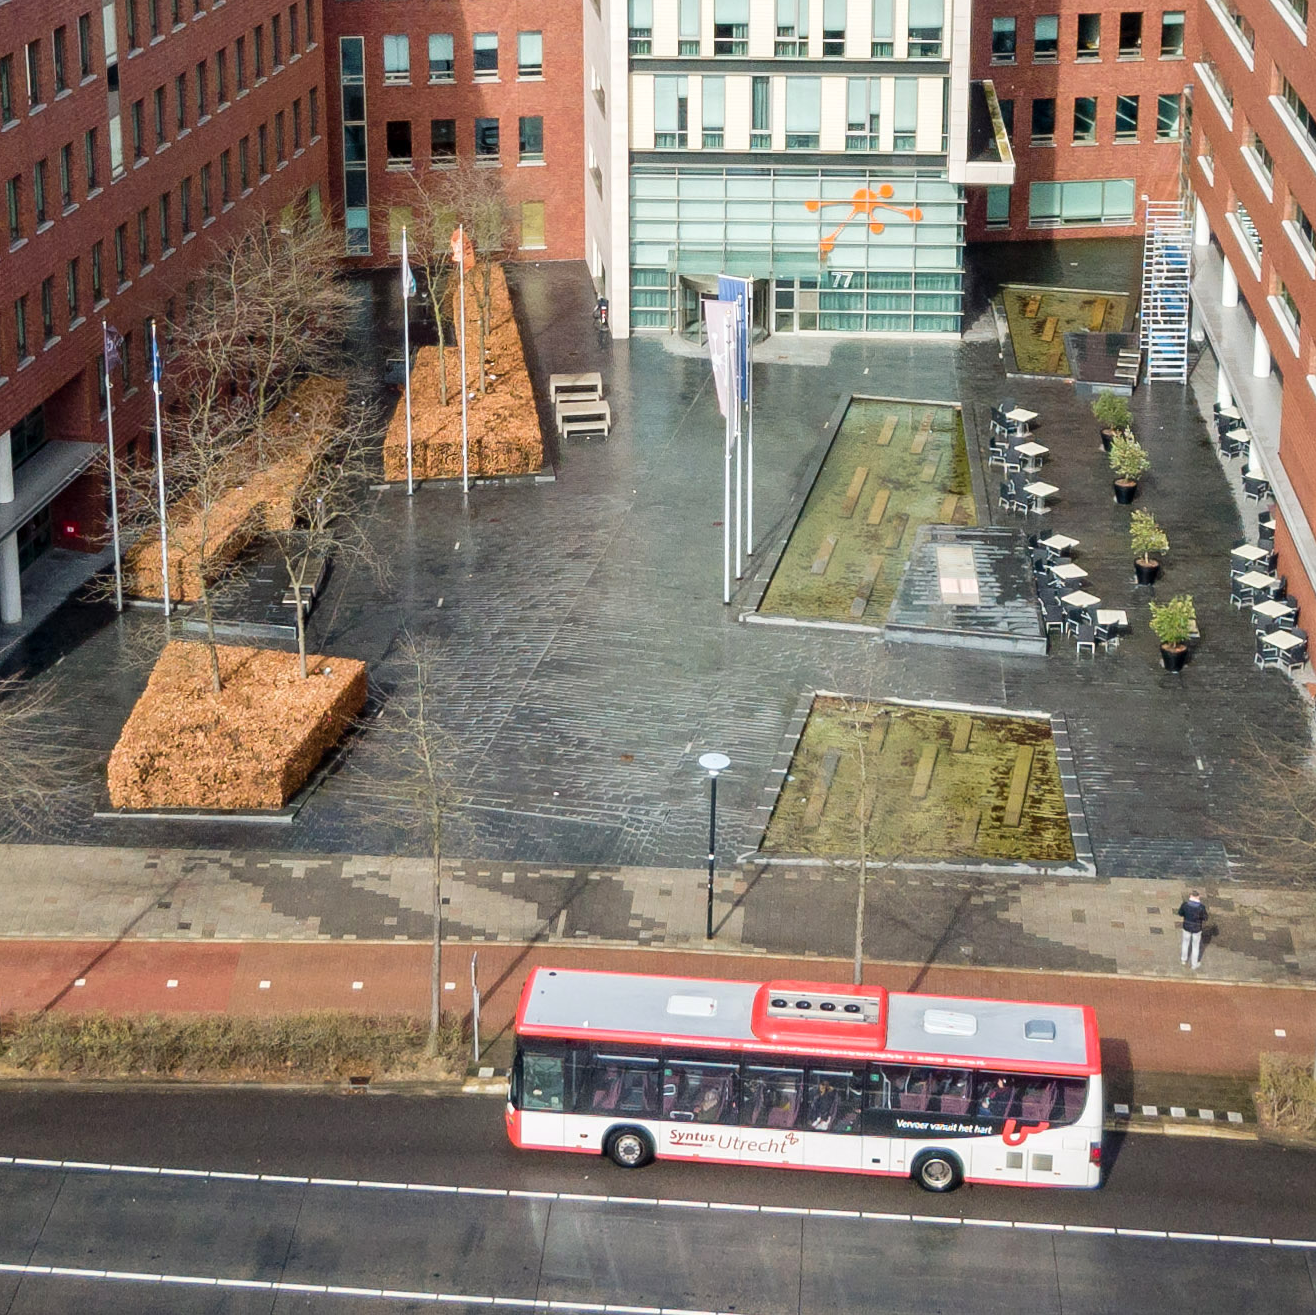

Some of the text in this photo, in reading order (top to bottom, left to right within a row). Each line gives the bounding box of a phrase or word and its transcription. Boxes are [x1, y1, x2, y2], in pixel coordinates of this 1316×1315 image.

[831, 272, 854, 288] 77
[896, 1119, 993, 1134] Vervoer vanuit het hart
[669, 1129, 787, 1154] Syntus Utrecht
